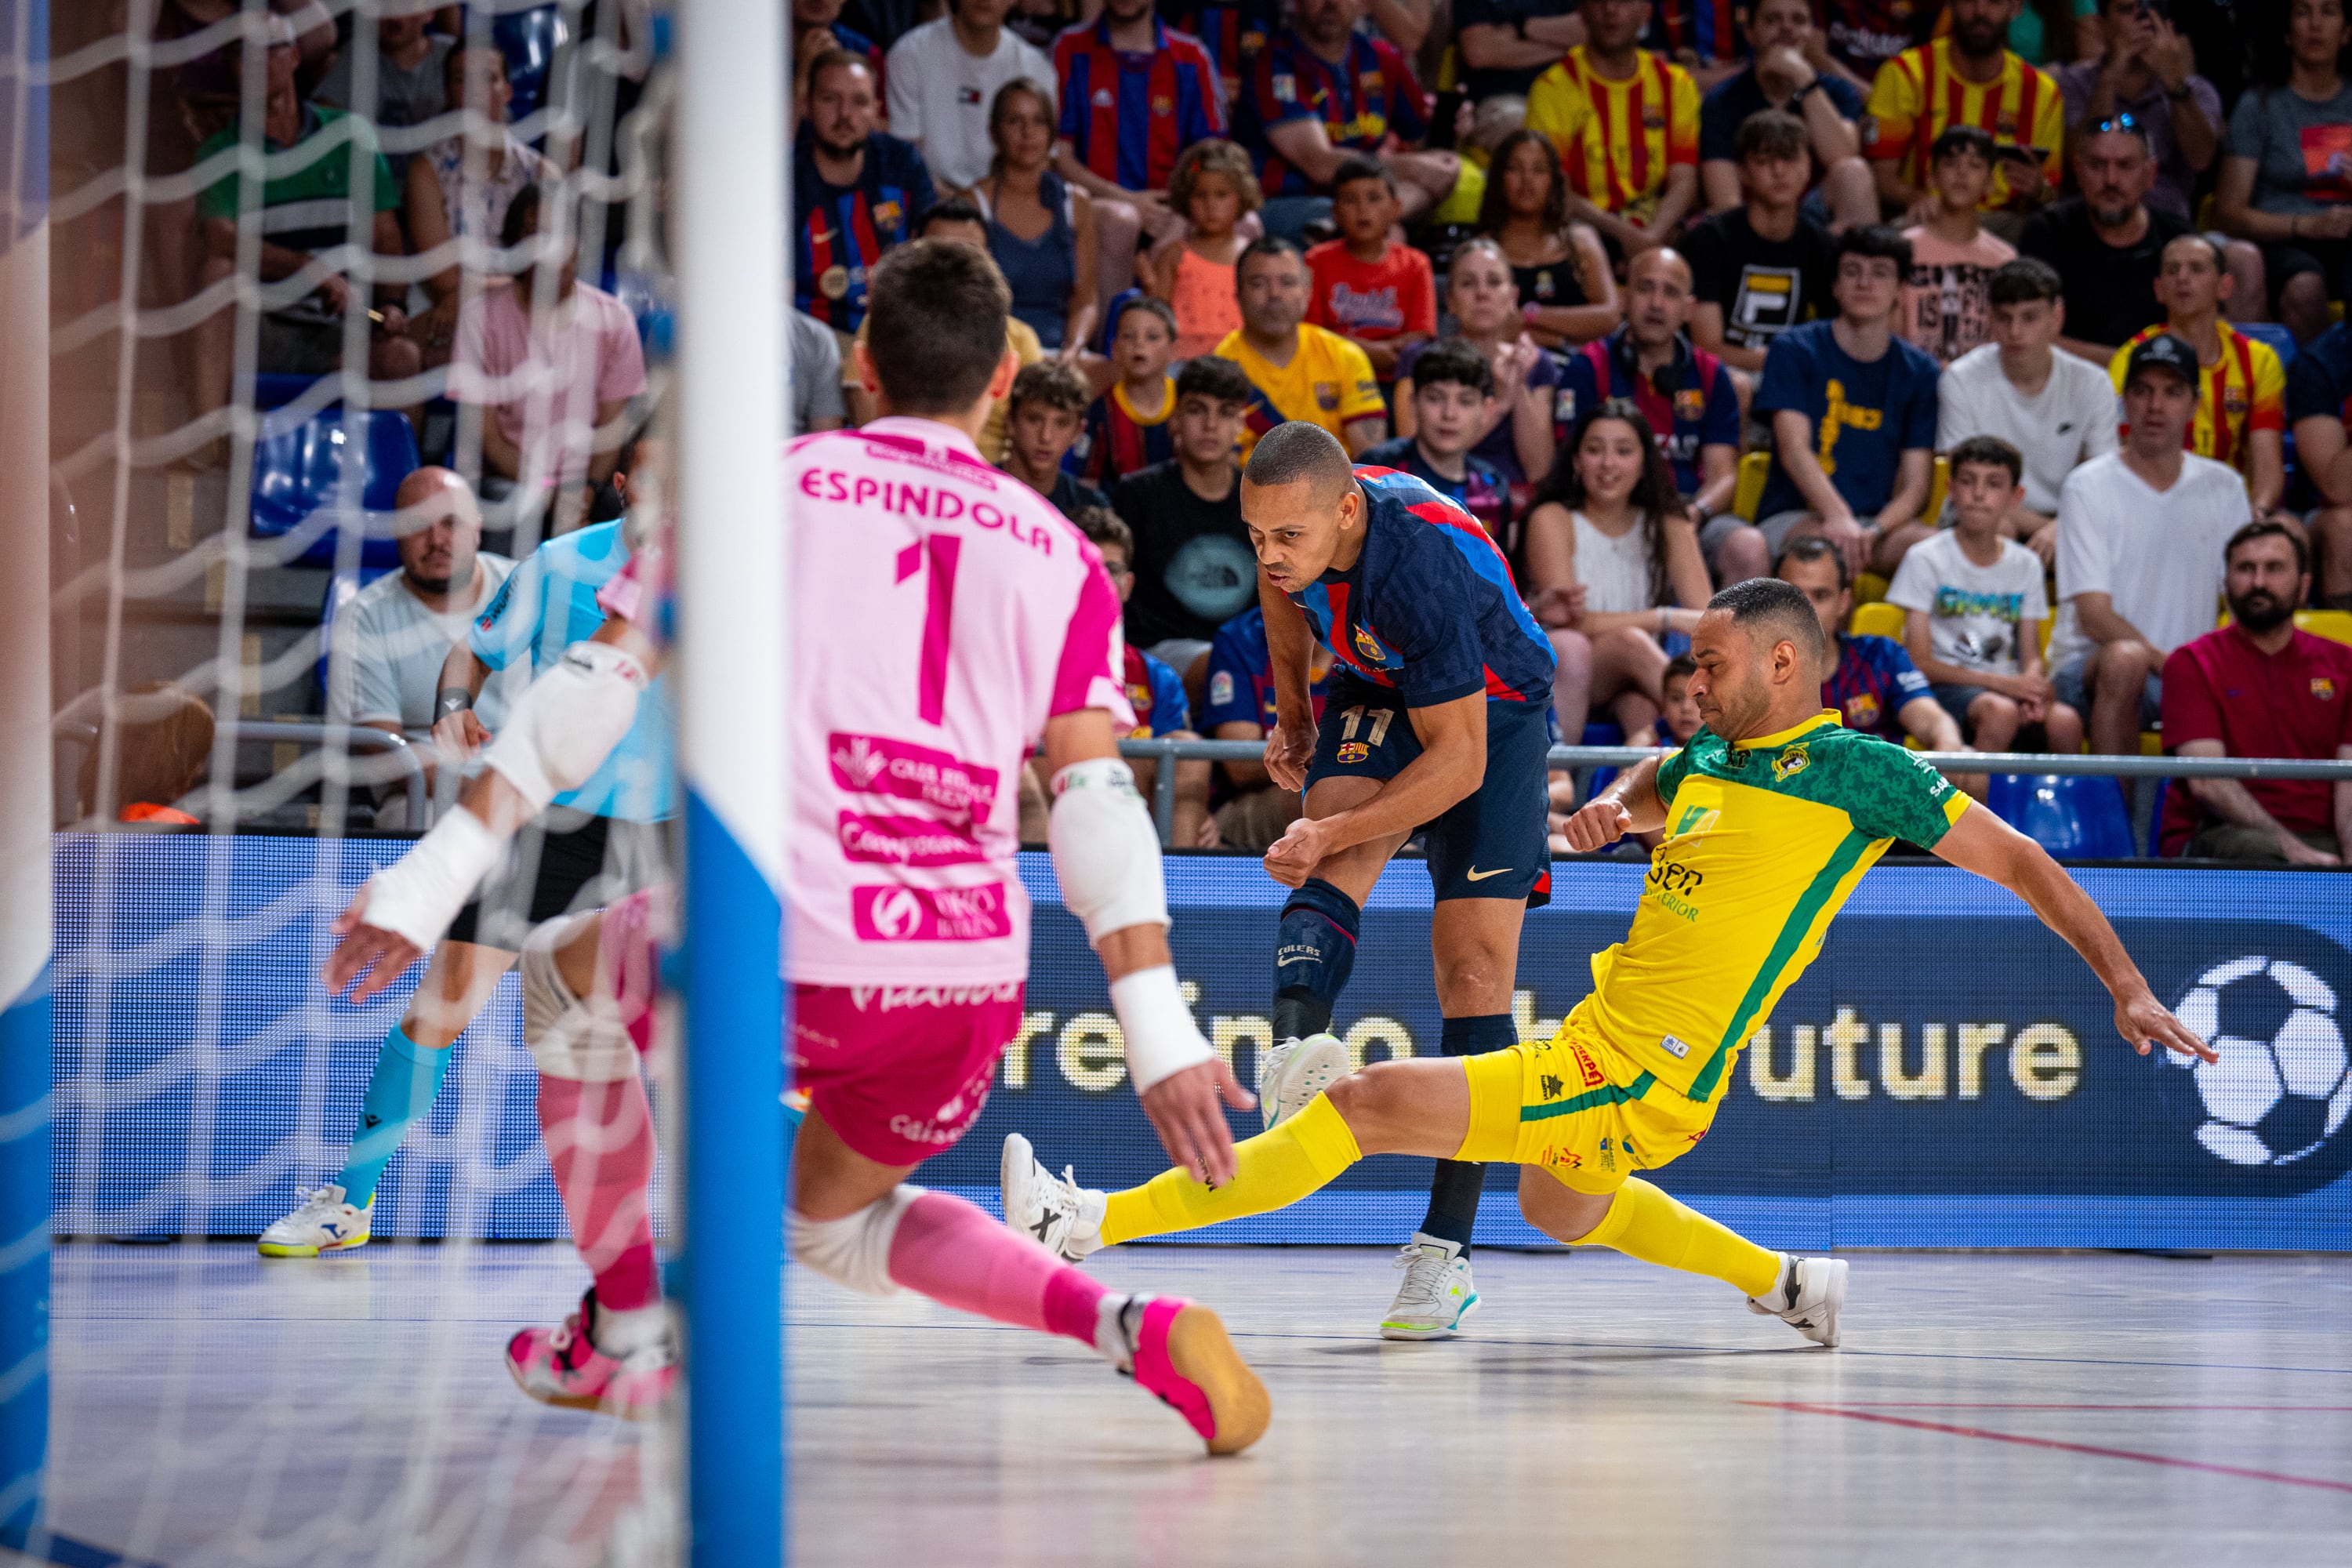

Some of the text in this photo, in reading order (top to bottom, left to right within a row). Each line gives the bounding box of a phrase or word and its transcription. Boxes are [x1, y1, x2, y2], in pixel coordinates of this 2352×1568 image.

[799, 468, 1052, 557] ESPINDOLA
[895, 533, 961, 727] 1
[1340, 706, 1395, 747] 11
[1278, 944, 1321, 956] CULERS
[1748, 1004, 2083, 1102] uture
